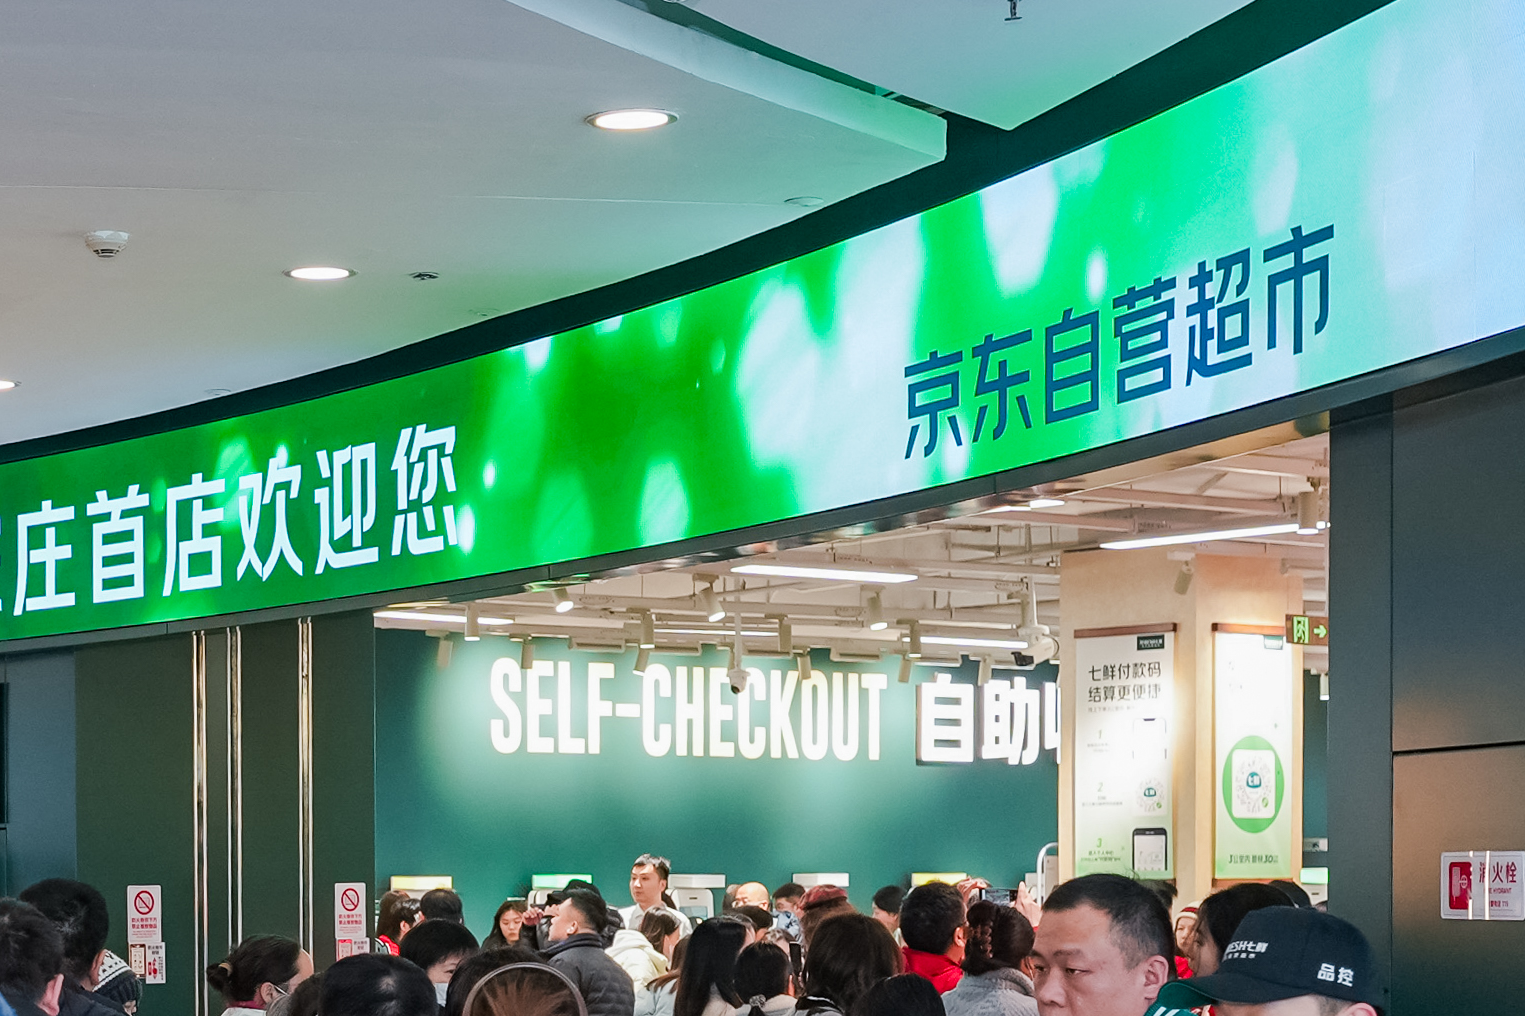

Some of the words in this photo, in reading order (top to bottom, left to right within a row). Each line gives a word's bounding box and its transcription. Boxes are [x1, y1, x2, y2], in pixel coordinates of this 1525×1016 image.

[904, 223, 1335, 460] 京东自营超市
[1088, 661, 1162, 682] 七鲜付款码
[489, 656, 888, 761] SELF-CHECKOUT
[1316, 962, 1355, 988] 品控
